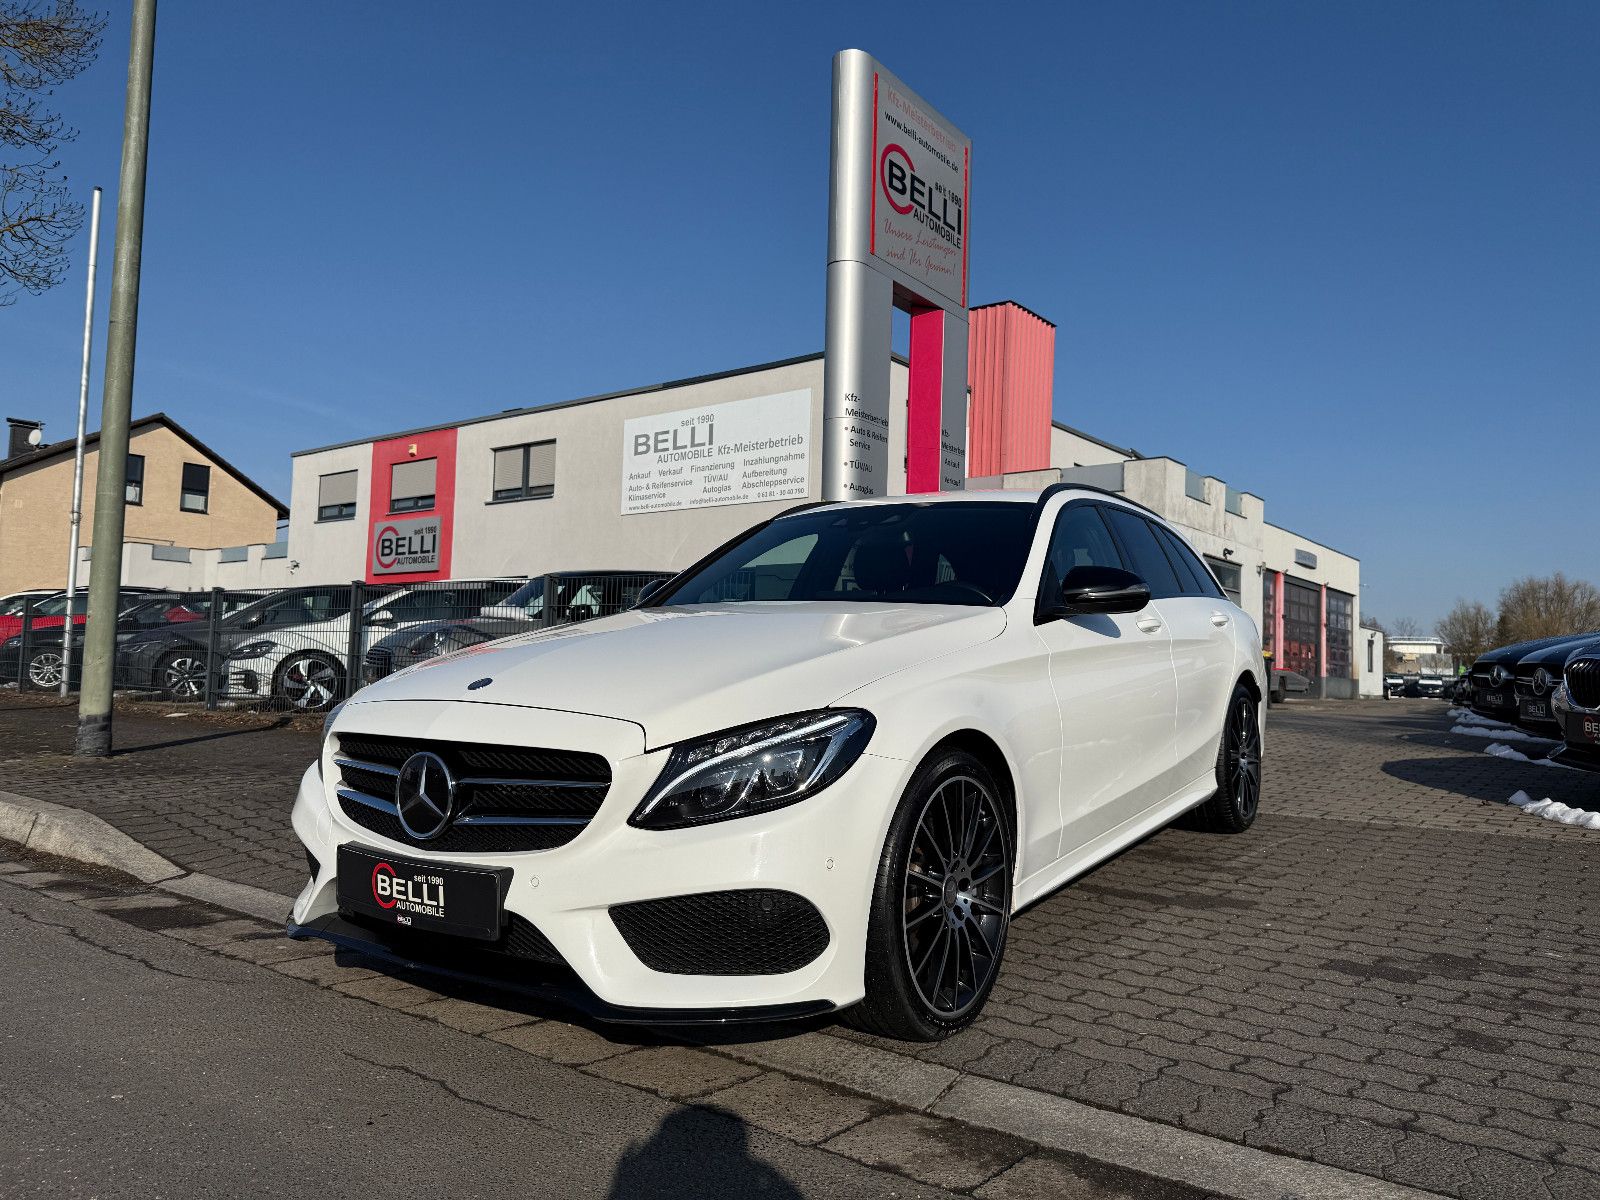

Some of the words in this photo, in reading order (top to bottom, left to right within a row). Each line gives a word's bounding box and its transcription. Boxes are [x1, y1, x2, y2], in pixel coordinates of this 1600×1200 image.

[888, 158, 962, 236] BELLI
[934, 182, 947, 198] seit
[913, 207, 962, 249] AUTOMOBILE
[845, 393, 861, 402] Kfz-
[681, 417, 695, 427] seit
[697, 413, 715, 425] 1990
[634, 423, 714, 456] BELLI
[717, 434, 804, 456] Kfz-Meisterbetrieb
[629, 471, 651, 480] Ankauf
[658, 467, 683, 477] Verkauf
[690, 462, 735, 473] Finanzierung
[743, 452, 806, 466] Inzahlungnahme
[657, 448, 713, 464] AUTOMOBILE
[629, 492, 667, 501] Klimaservice
[702, 484, 732, 494] Autoglas
[742, 477, 805, 490] Abschleppservice
[651, 479, 693, 489] Reifenservice
[742, 468, 788, 480] Aufbereitung
[381, 534, 436, 557] BELLI
[397, 555, 436, 565] AUTOMOBILE
[377, 873, 445, 906] BELLI
[413, 874, 426, 883] seit
[428, 875, 444, 885] 1990
[396, 900, 445, 918] AUTOMOBILE
